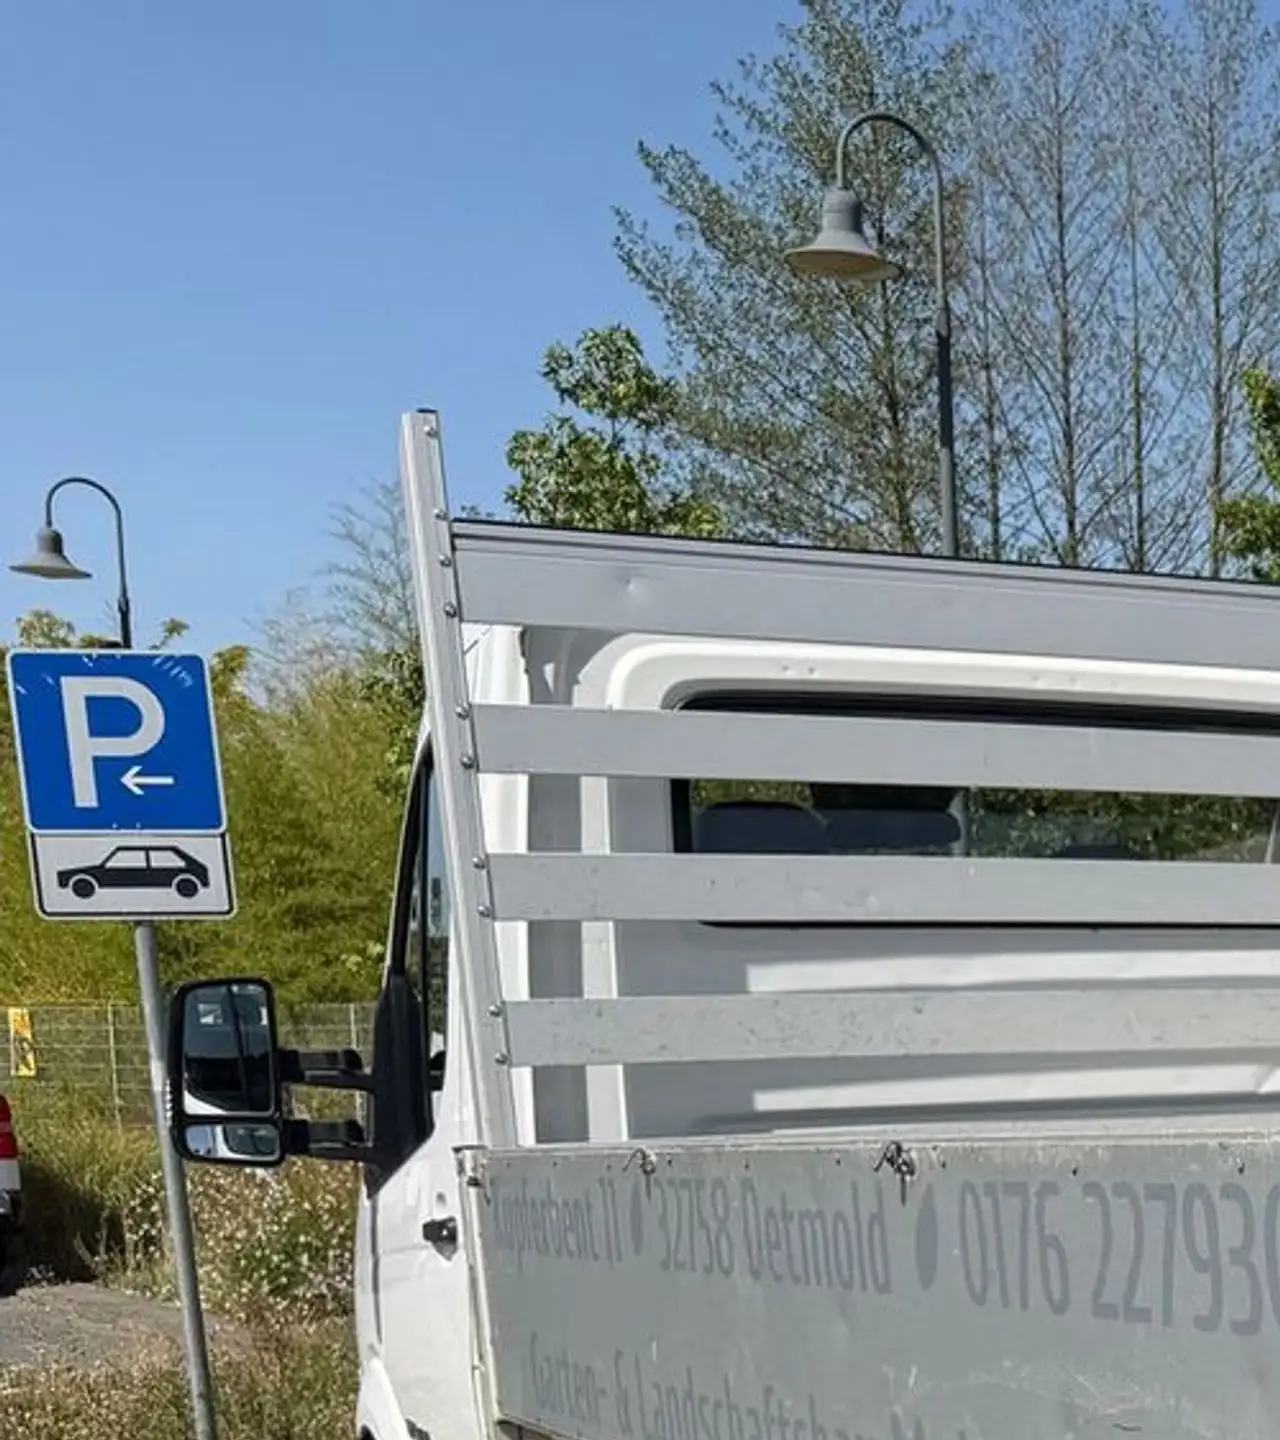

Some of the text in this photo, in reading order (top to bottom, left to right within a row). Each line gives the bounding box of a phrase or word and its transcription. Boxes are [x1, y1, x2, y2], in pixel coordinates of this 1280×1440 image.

[60, 676, 165, 807] P
[740, 1177, 892, 1295] Detmold
[962, 1188, 1068, 1317] 0176
